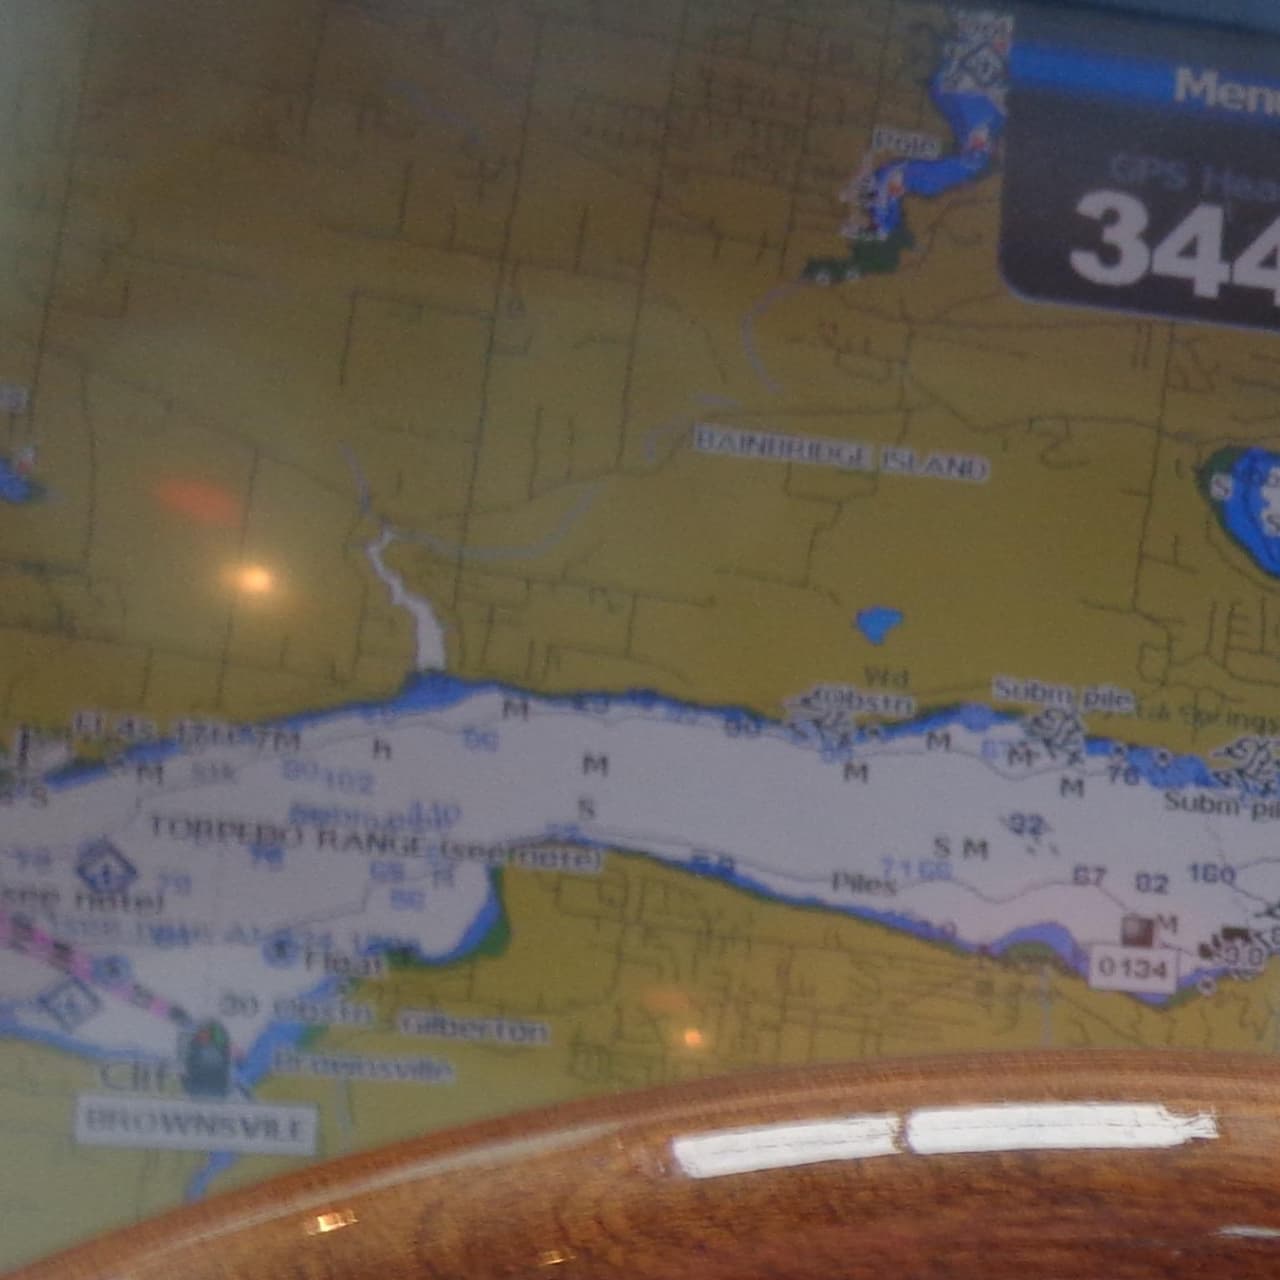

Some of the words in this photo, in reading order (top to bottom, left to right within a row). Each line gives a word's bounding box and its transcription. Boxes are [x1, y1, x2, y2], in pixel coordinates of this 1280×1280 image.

[1108, 153, 1189, 190] GPS
[883, 449, 988, 482] ISLAND
[1165, 792, 1241, 817] Subm
